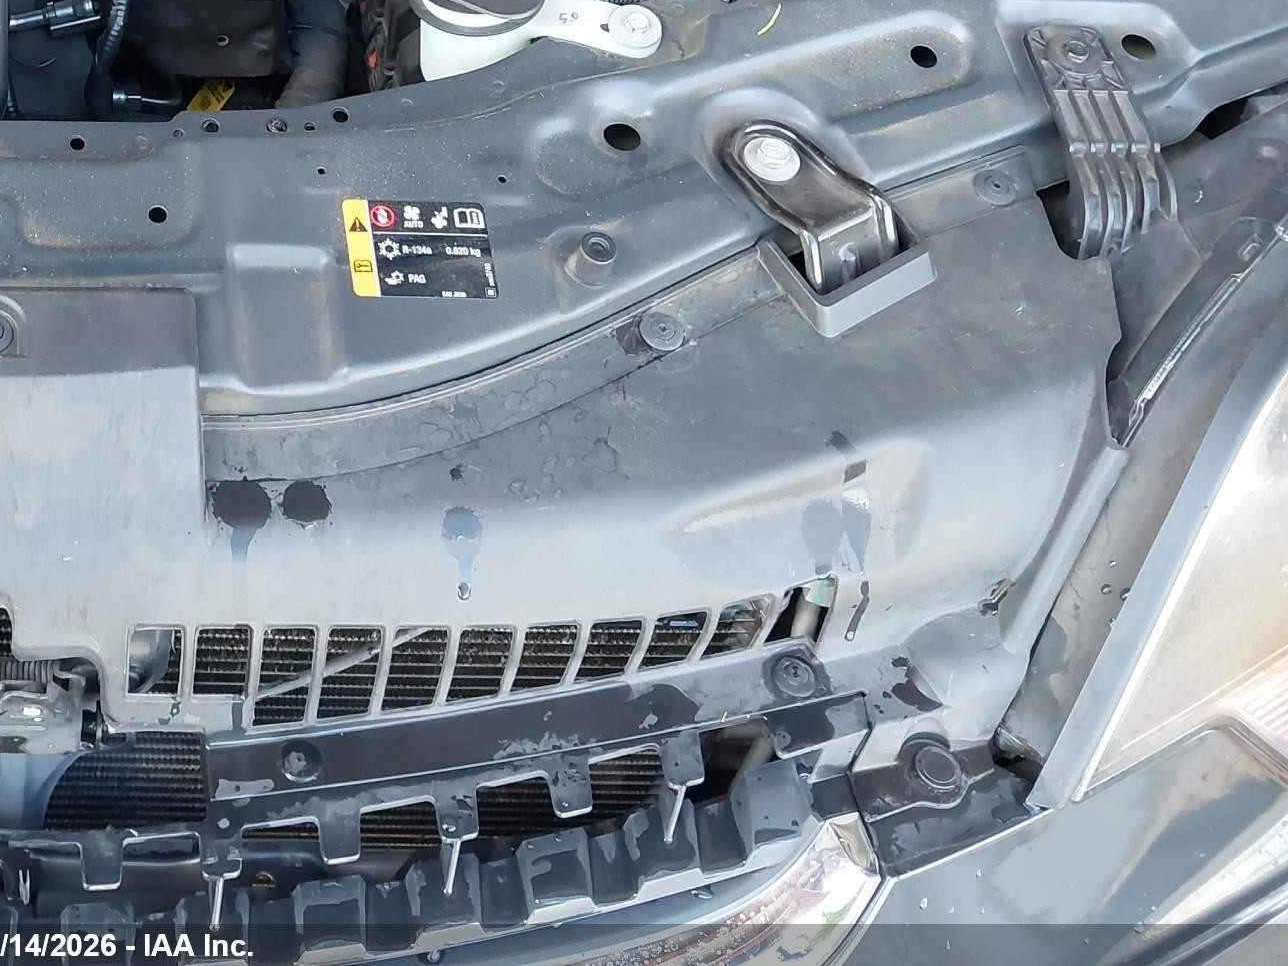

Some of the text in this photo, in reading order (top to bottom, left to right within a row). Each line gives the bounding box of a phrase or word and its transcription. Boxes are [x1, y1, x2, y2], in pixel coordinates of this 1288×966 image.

[403, 220, 424, 229] AUTO
[401, 245, 481, 258] R-134a 0.620 kg
[407, 273, 427, 284] PAG
